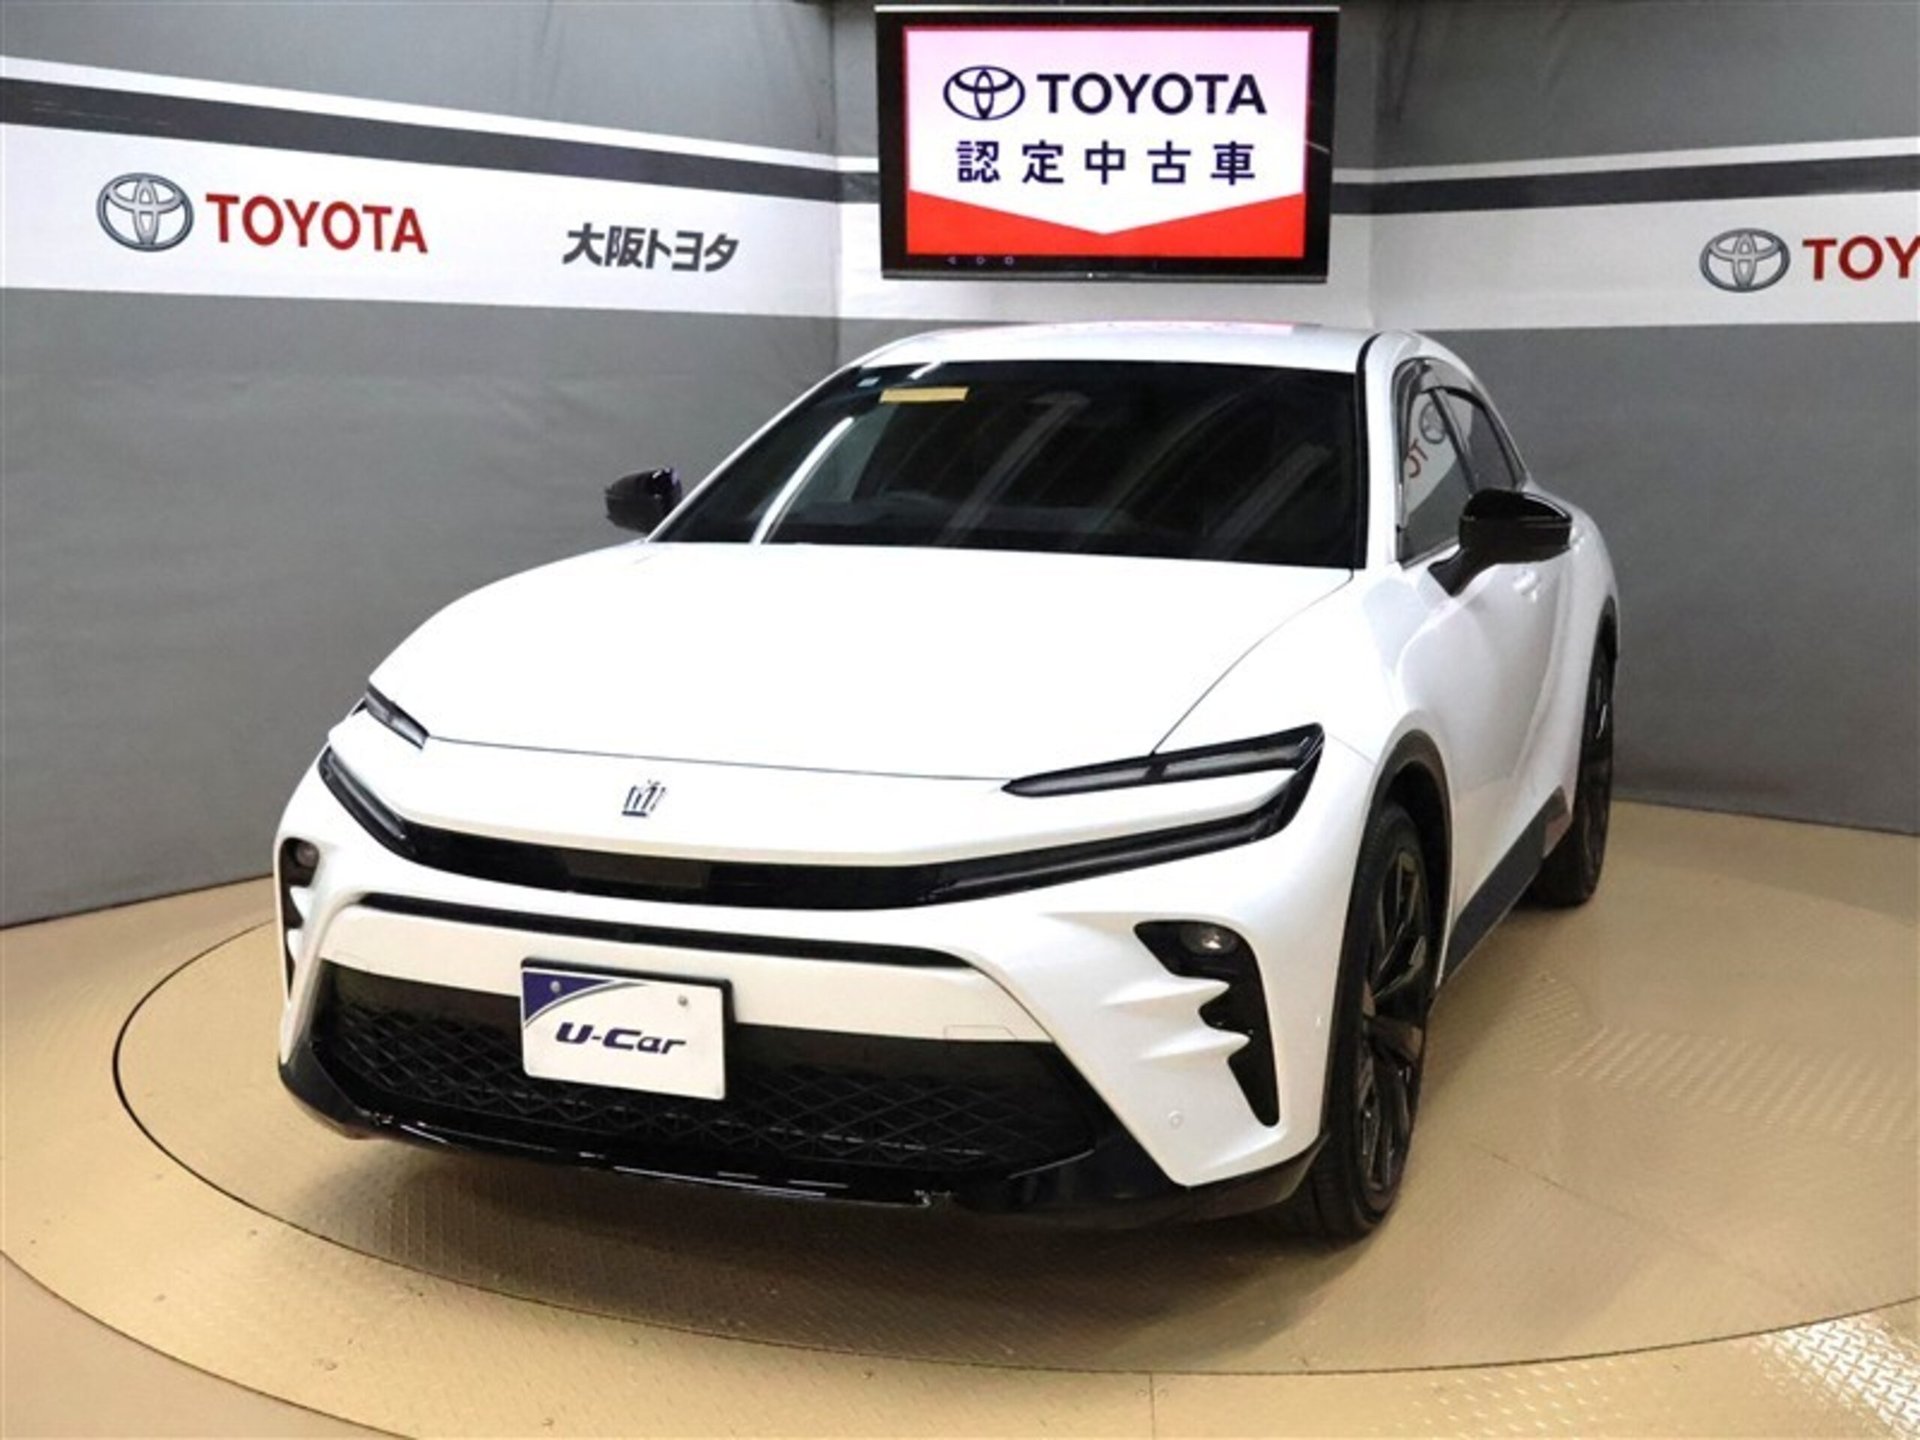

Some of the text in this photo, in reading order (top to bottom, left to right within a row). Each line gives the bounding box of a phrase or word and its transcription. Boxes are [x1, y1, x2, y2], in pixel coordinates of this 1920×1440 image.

[1036, 72, 1267, 116] TOYOTA
[956, 139, 1256, 186] 認定中古車
[205, 192, 428, 254] TOYOTA
[562, 222, 740, 273] 大阪トヨタ
[555, 1022, 687, 1055] U-Car
